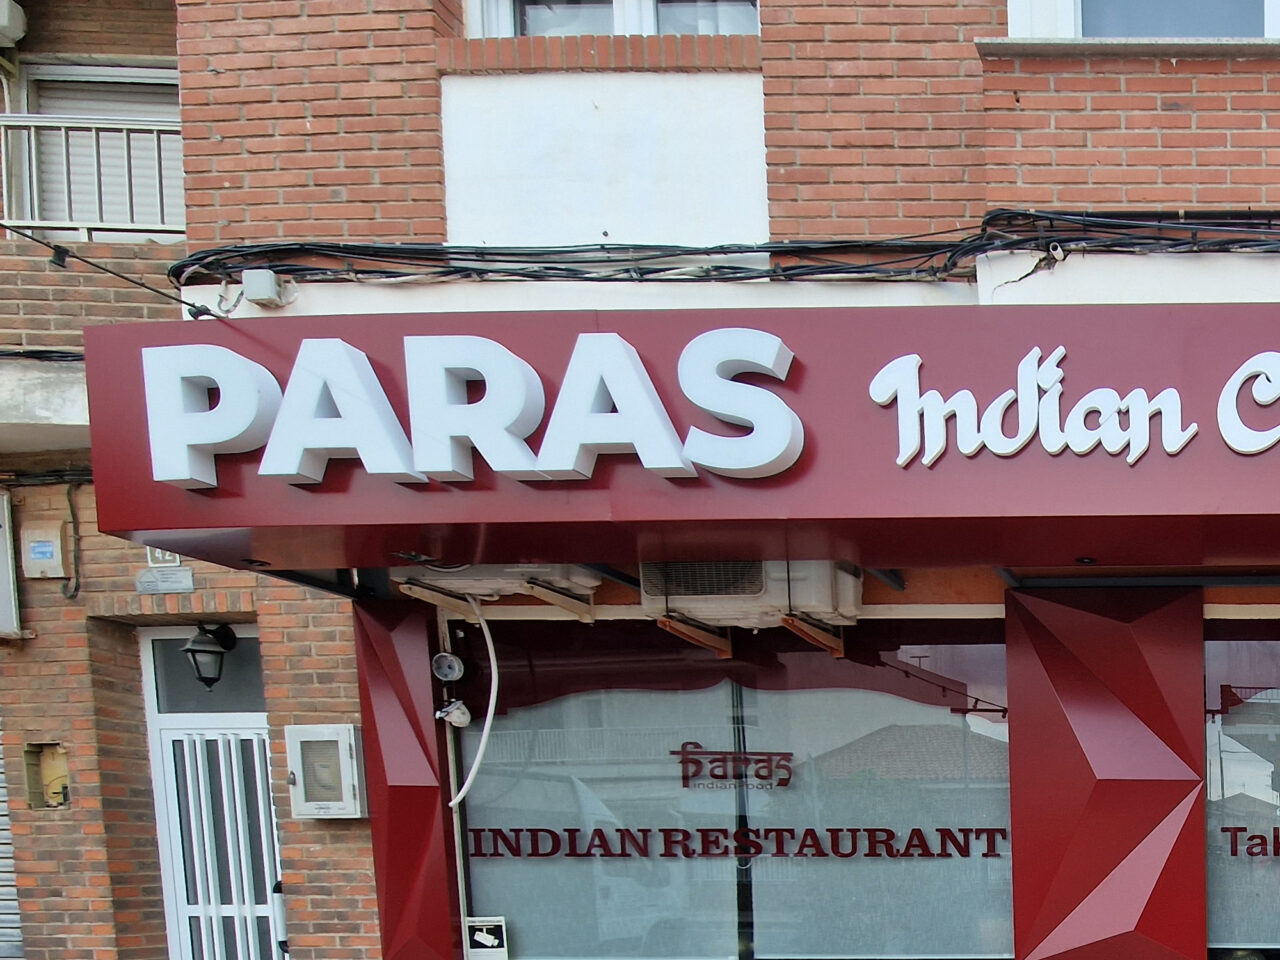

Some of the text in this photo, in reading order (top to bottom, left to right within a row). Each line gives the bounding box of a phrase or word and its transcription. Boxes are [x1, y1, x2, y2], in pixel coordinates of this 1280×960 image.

[141, 327, 805, 489] PARAS
[868, 345, 1199, 467] Indian
[468, 827, 1007, 858] INDIAN RESTAURANT
